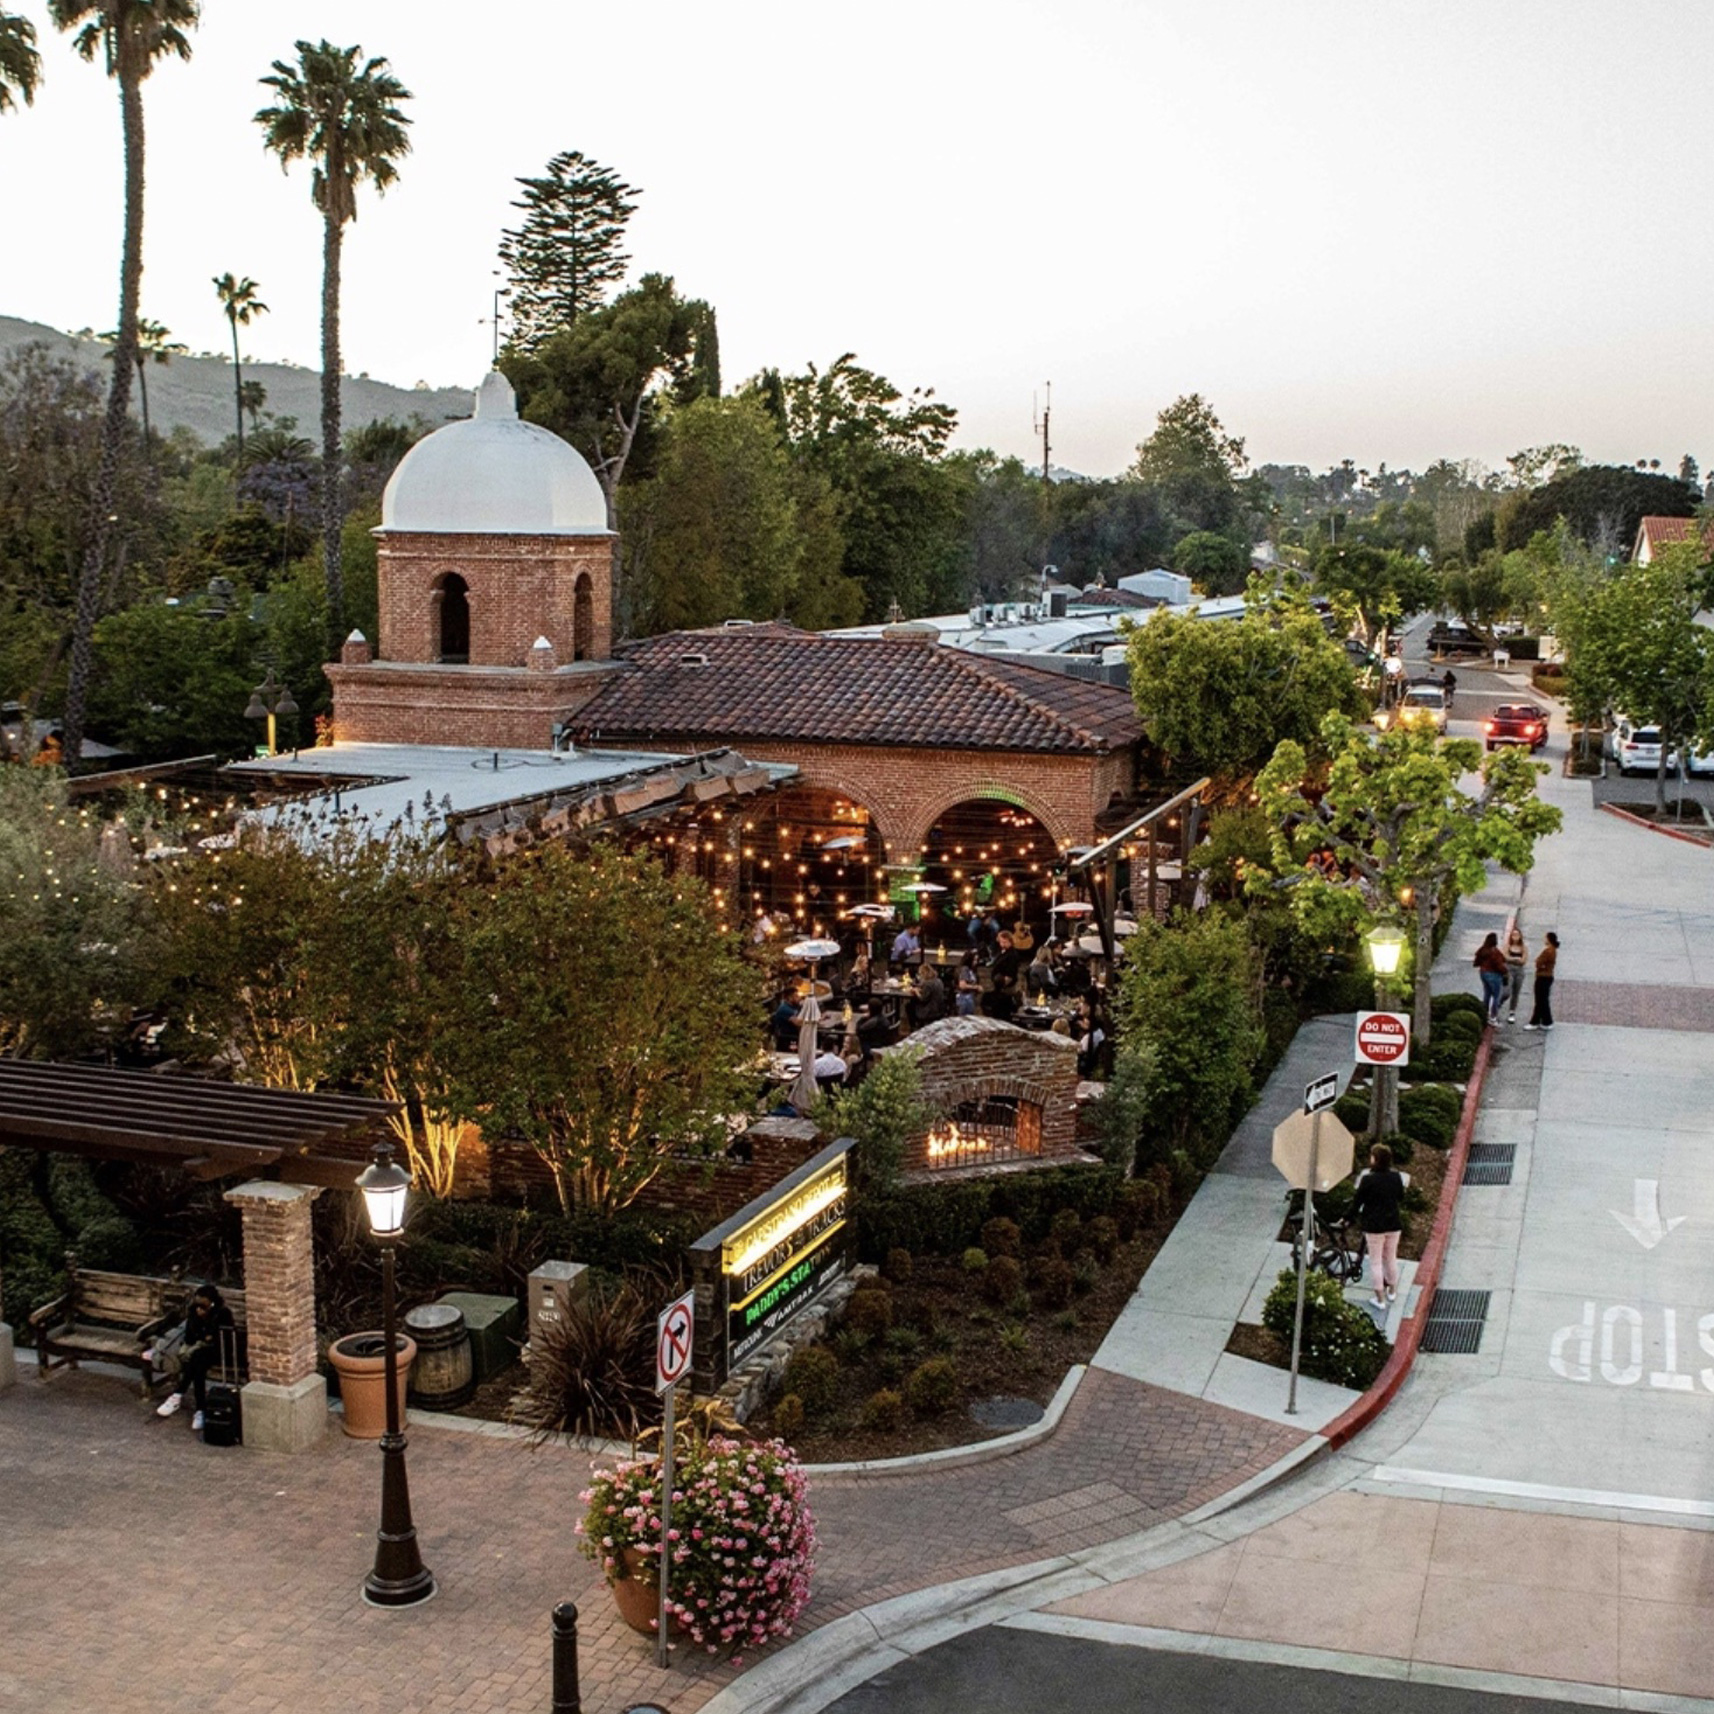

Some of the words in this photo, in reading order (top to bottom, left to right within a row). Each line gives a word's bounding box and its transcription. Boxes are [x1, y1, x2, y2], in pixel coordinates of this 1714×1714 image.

[1365, 1022, 1379, 1032] DO
[1381, 1023, 1400, 1033] NOT
[1367, 1044, 1397, 1055] ENTER
